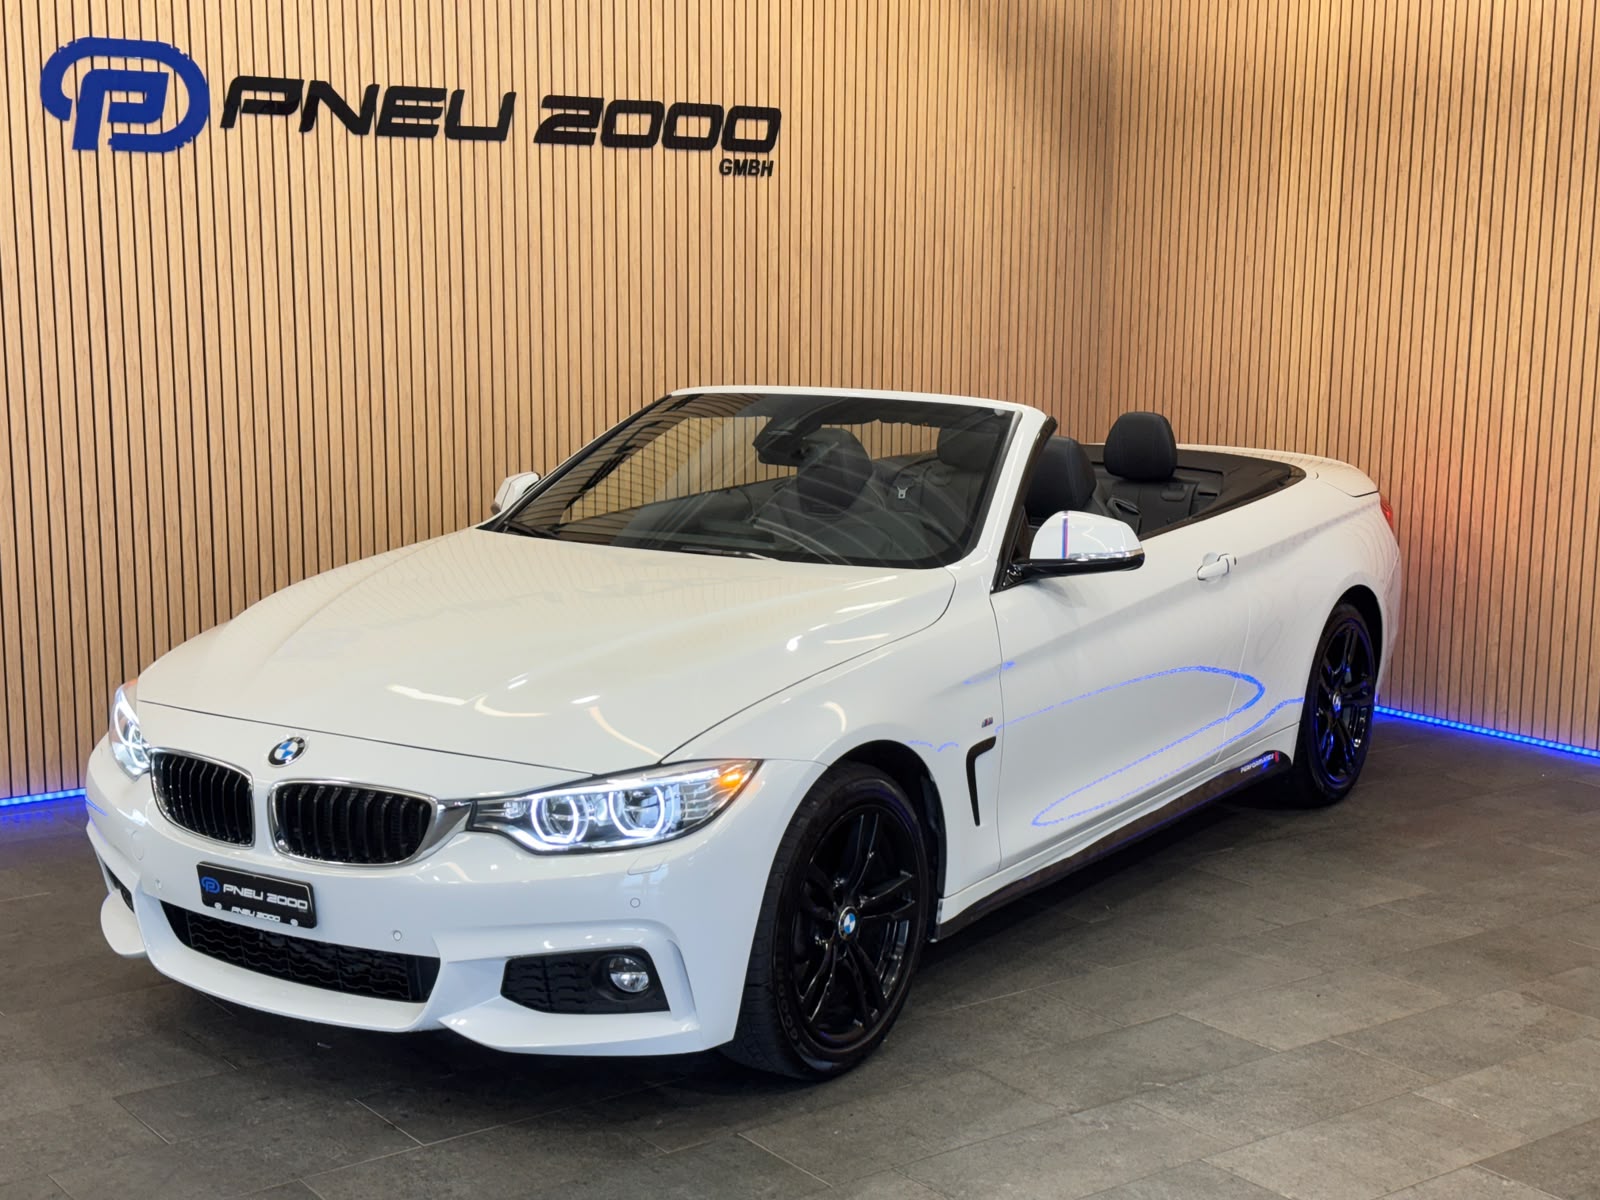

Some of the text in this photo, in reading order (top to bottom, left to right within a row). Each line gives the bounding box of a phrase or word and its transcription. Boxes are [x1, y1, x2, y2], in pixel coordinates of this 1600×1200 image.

[220, 75, 781, 153] PNEU 2000
[719, 158, 774, 177] GMBH
[223, 883, 308, 910] PNEU 2000
[256, 911, 280, 922] 2000
